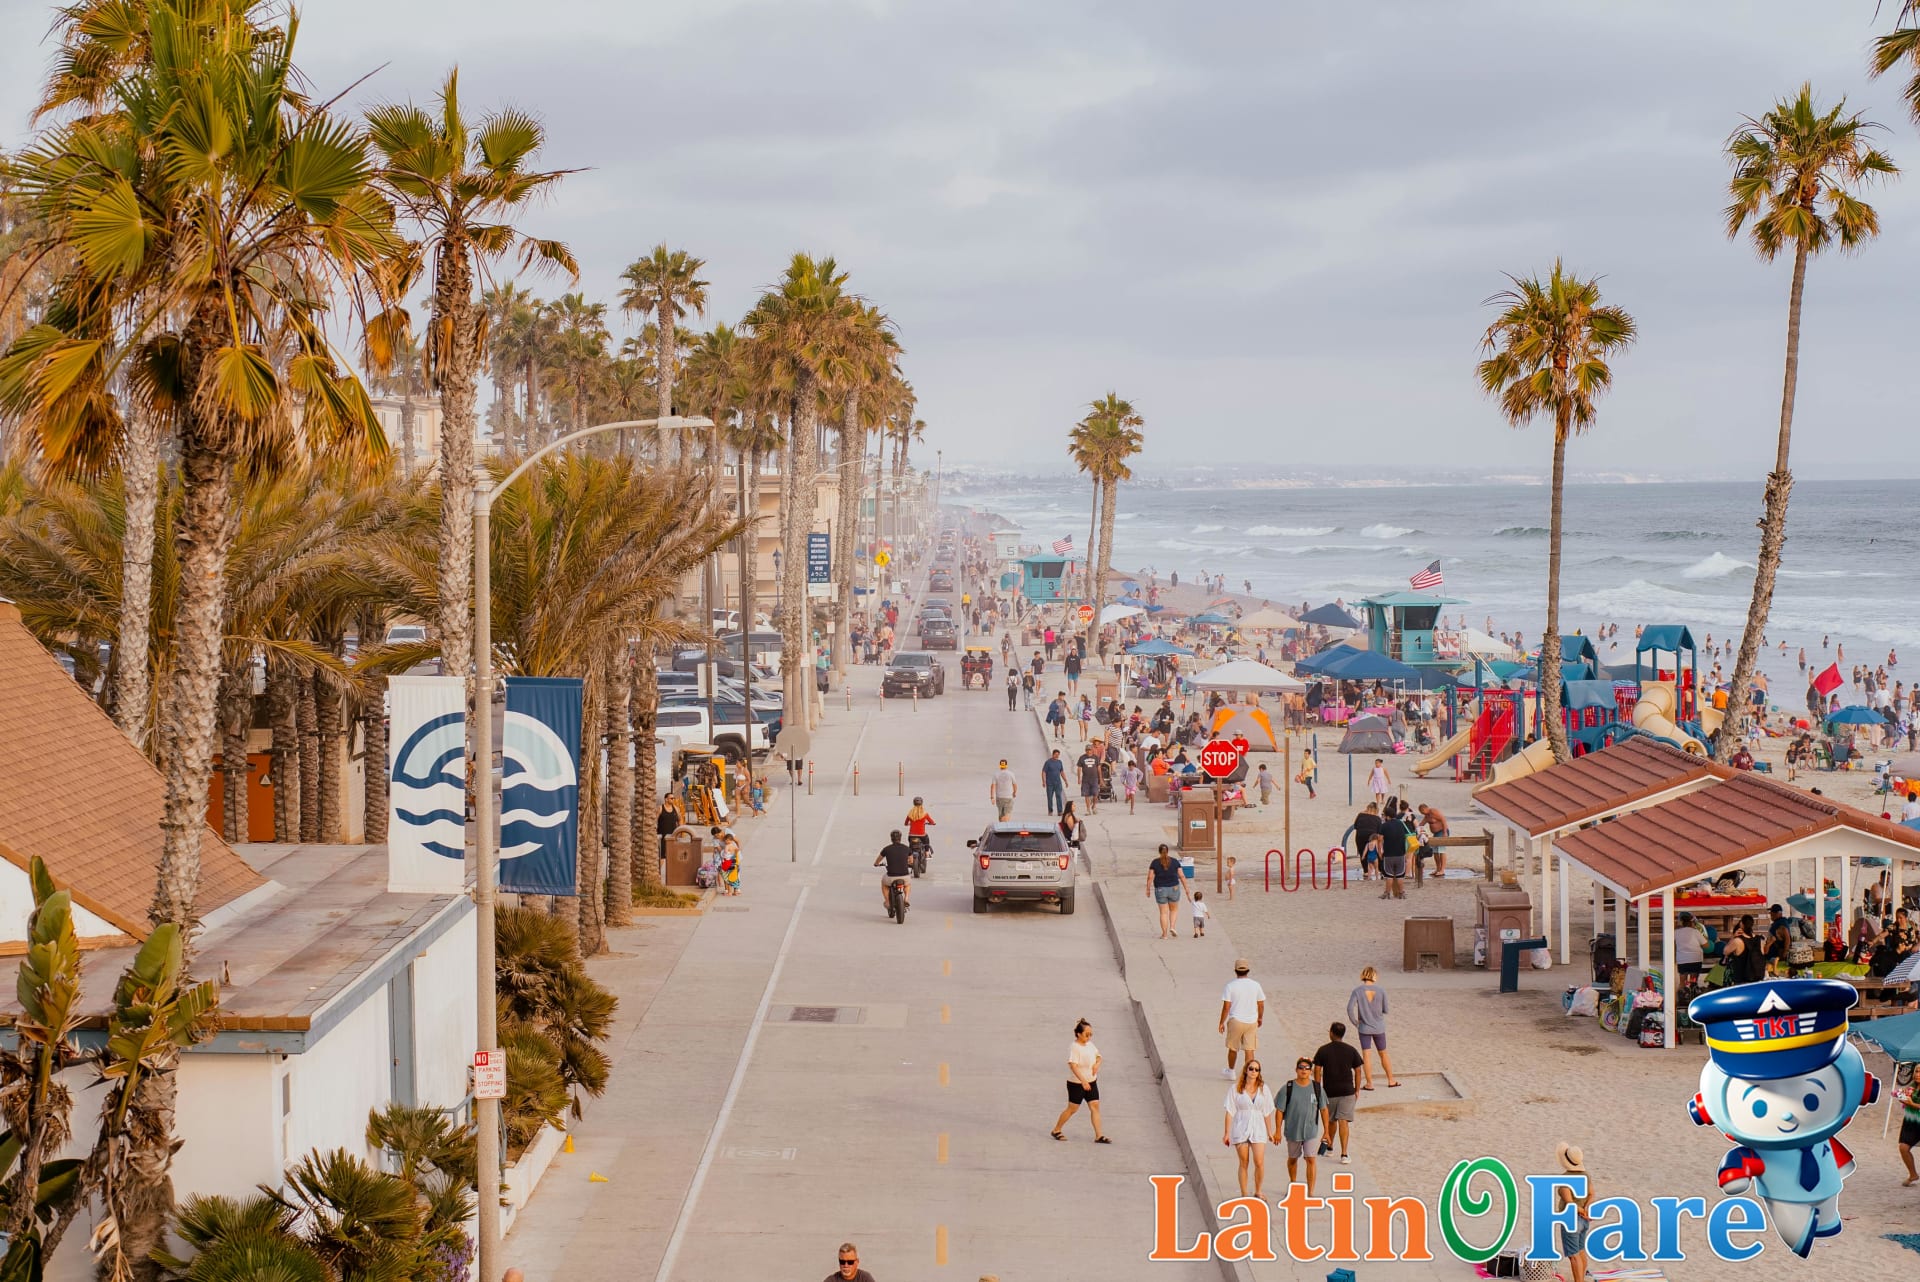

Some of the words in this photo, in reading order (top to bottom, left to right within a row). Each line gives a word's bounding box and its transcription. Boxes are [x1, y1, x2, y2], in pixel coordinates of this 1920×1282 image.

[1048, 582, 1055, 590] 3
[1414, 636, 1421, 649] 1
[1203, 751, 1236, 766] STOP
[476, 1054, 487, 1065] NO
